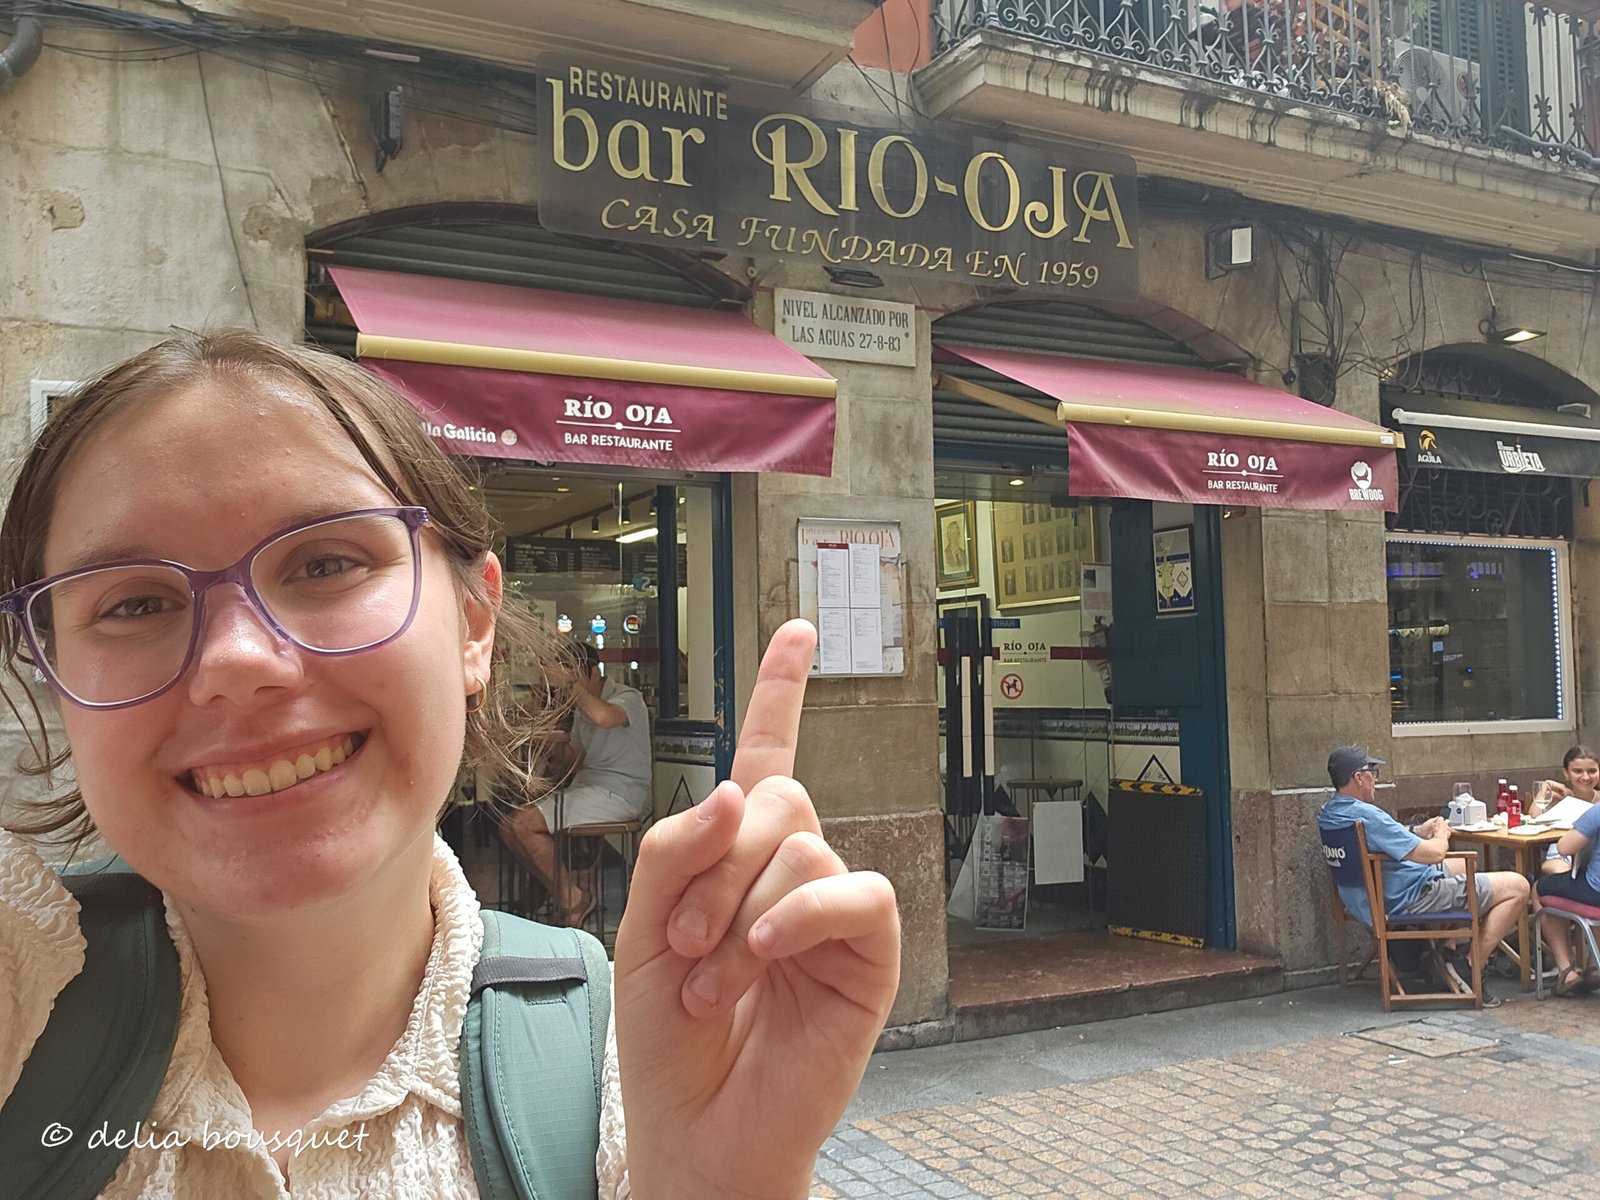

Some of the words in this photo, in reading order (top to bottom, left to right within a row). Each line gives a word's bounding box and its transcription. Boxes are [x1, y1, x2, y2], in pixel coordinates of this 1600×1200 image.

[569, 66, 728, 120] RESTAURANTE
[545, 77, 705, 187] bar
[752, 112, 1134, 249] RIO-OJA
[601, 198, 718, 242] CASA
[737, 217, 955, 272] FUNDADA
[965, 250, 1029, 286] EN
[1038, 261, 1099, 288] 1959
[782, 298, 818, 319] NIVEL
[821, 303, 886, 326] ALCANZADO
[889, 311, 909, 329] POR
[791, 325, 815, 344] LAS
[818, 328, 855, 348] AGUAS
[859, 333, 901, 353] 27-8-83
[564, 395, 613, 419] RÍO
[625, 404, 673, 426] OJA
[443, 422, 497, 443] Galicia
[564, 432, 588, 445] BAR
[591, 434, 673, 451] RESTAURANTE
[1207, 449, 1240, 468] RÍO
[1247, 454, 1279, 472] OJA
[1207, 480, 1224, 490] BAR
[1225, 481, 1279, 494] RESTAURANTE
[1349, 488, 1385, 501] BREWDOG
[1003, 640, 1022, 651] RÍO
[1027, 642, 1047, 652] OJA
